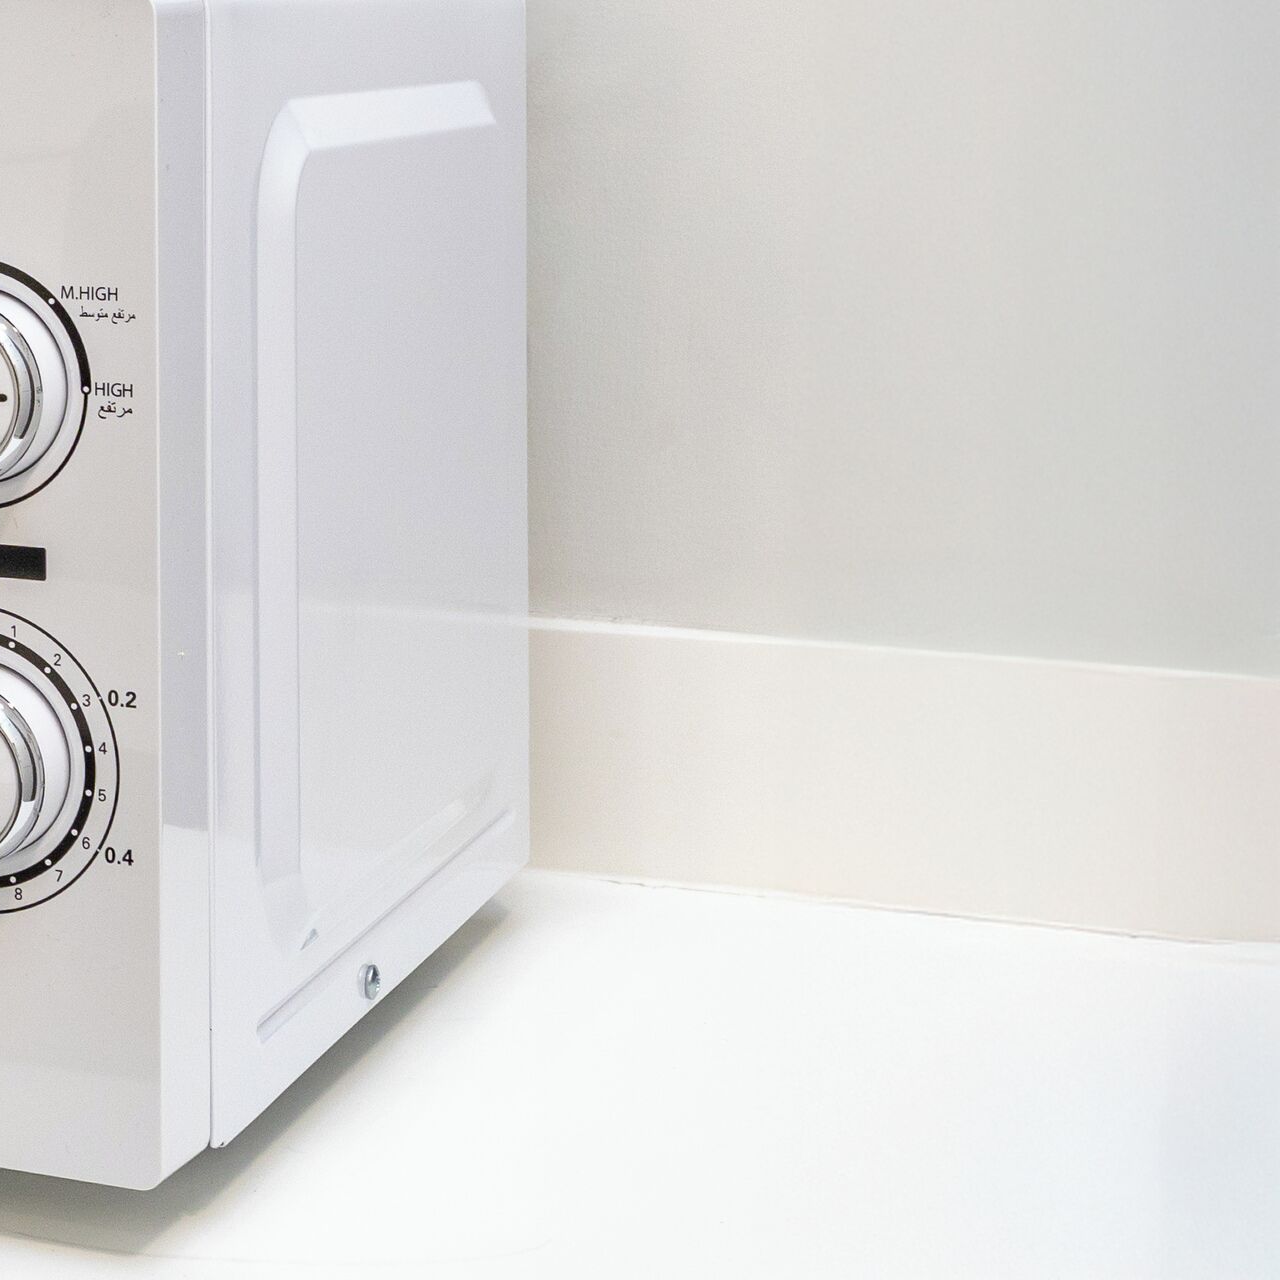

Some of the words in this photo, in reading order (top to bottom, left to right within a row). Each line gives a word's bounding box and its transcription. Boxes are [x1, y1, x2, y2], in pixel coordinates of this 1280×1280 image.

[61, 285, 118, 301] M.HIGH
[80, 306, 108, 321] متوسط
[111, 308, 136, 324] مرتفع
[94, 382, 133, 398] HIGH
[98, 401, 133, 419] مرتفع
[11, 626, 16, 637] 1
[54, 654, 62, 666] 2
[82, 695, 91, 706] 3
[108, 690, 137, 709] 0.2
[99, 742, 107, 754] 4
[98, 789, 106, 801] 5
[82, 837, 90, 849] 6
[105, 847, 134, 866] 0.4
[55, 870, 63, 882] 7
[15, 888, 22, 900] 8
